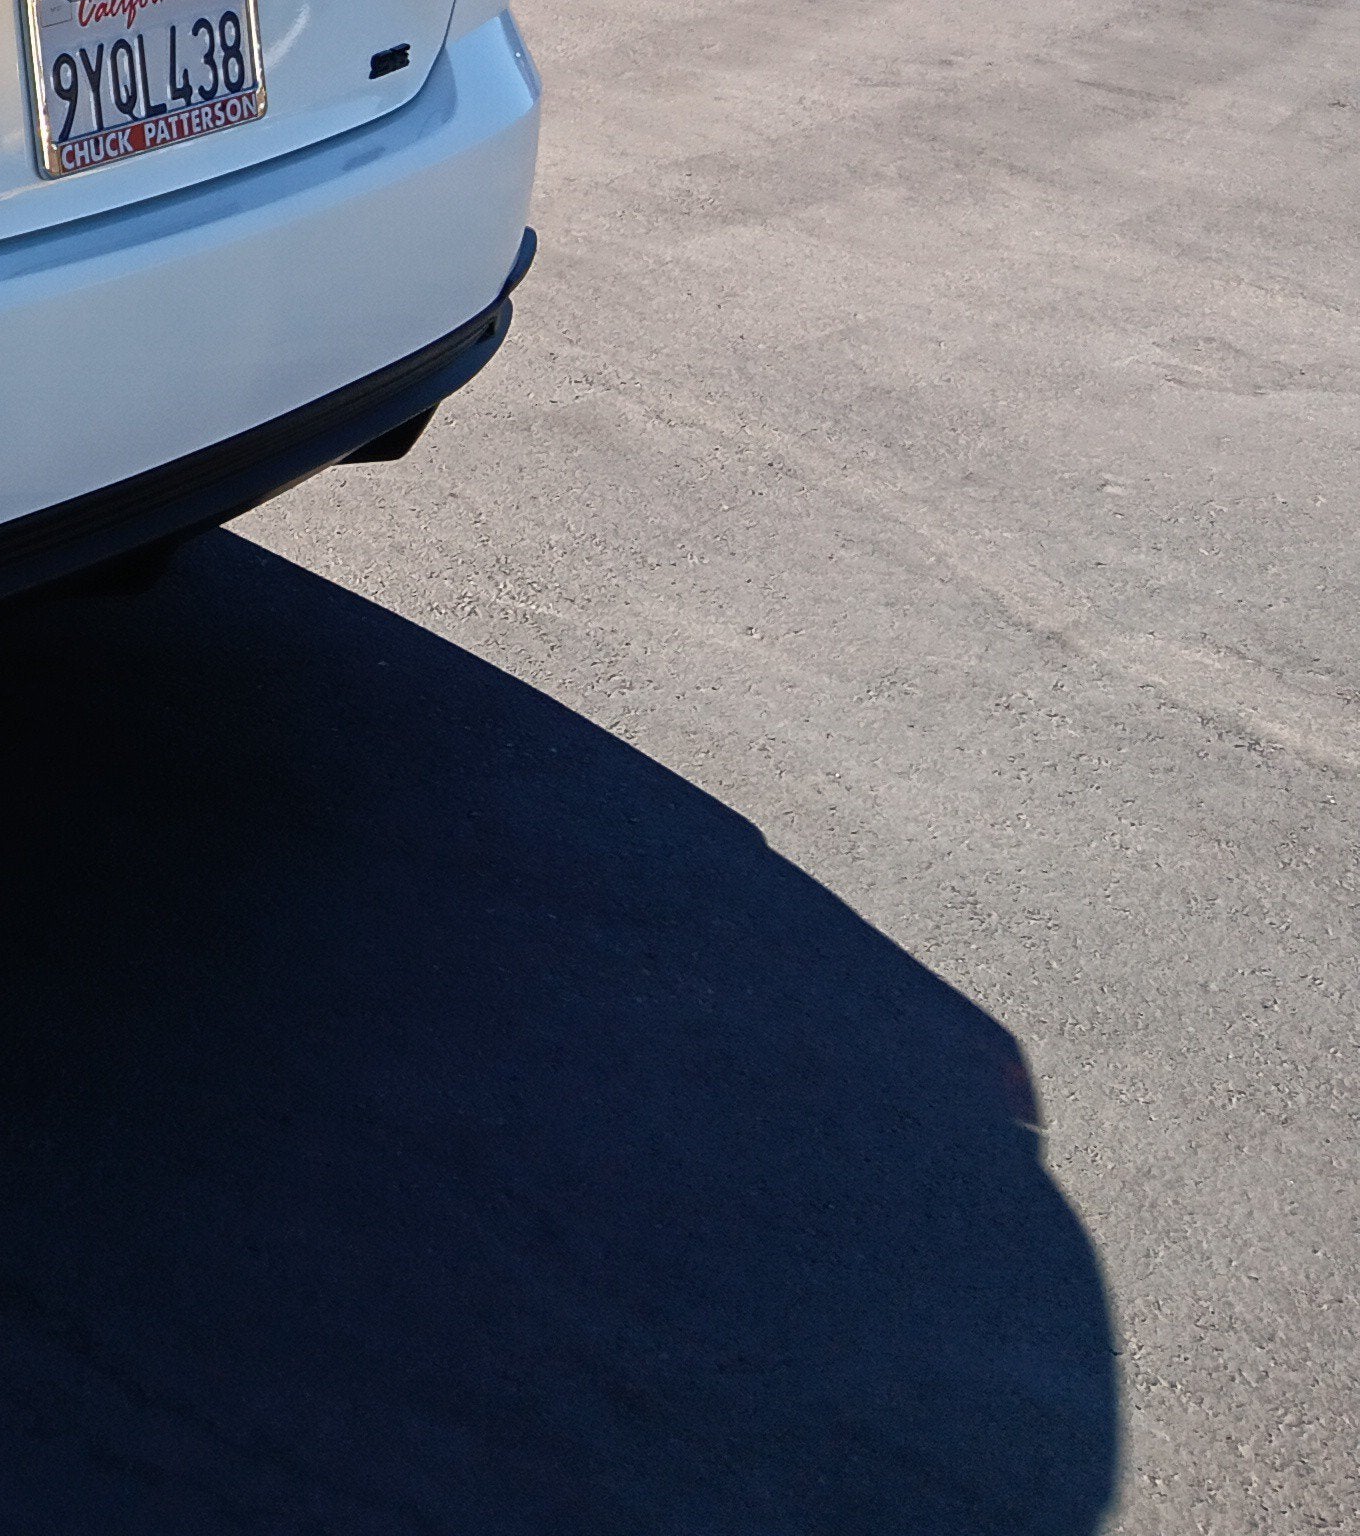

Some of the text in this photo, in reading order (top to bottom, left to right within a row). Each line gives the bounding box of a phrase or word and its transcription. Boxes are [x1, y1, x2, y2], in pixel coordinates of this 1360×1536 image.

[51, 10, 246, 143] 9YQL438
[61, 95, 257, 170] CHUCK PATTERSON
